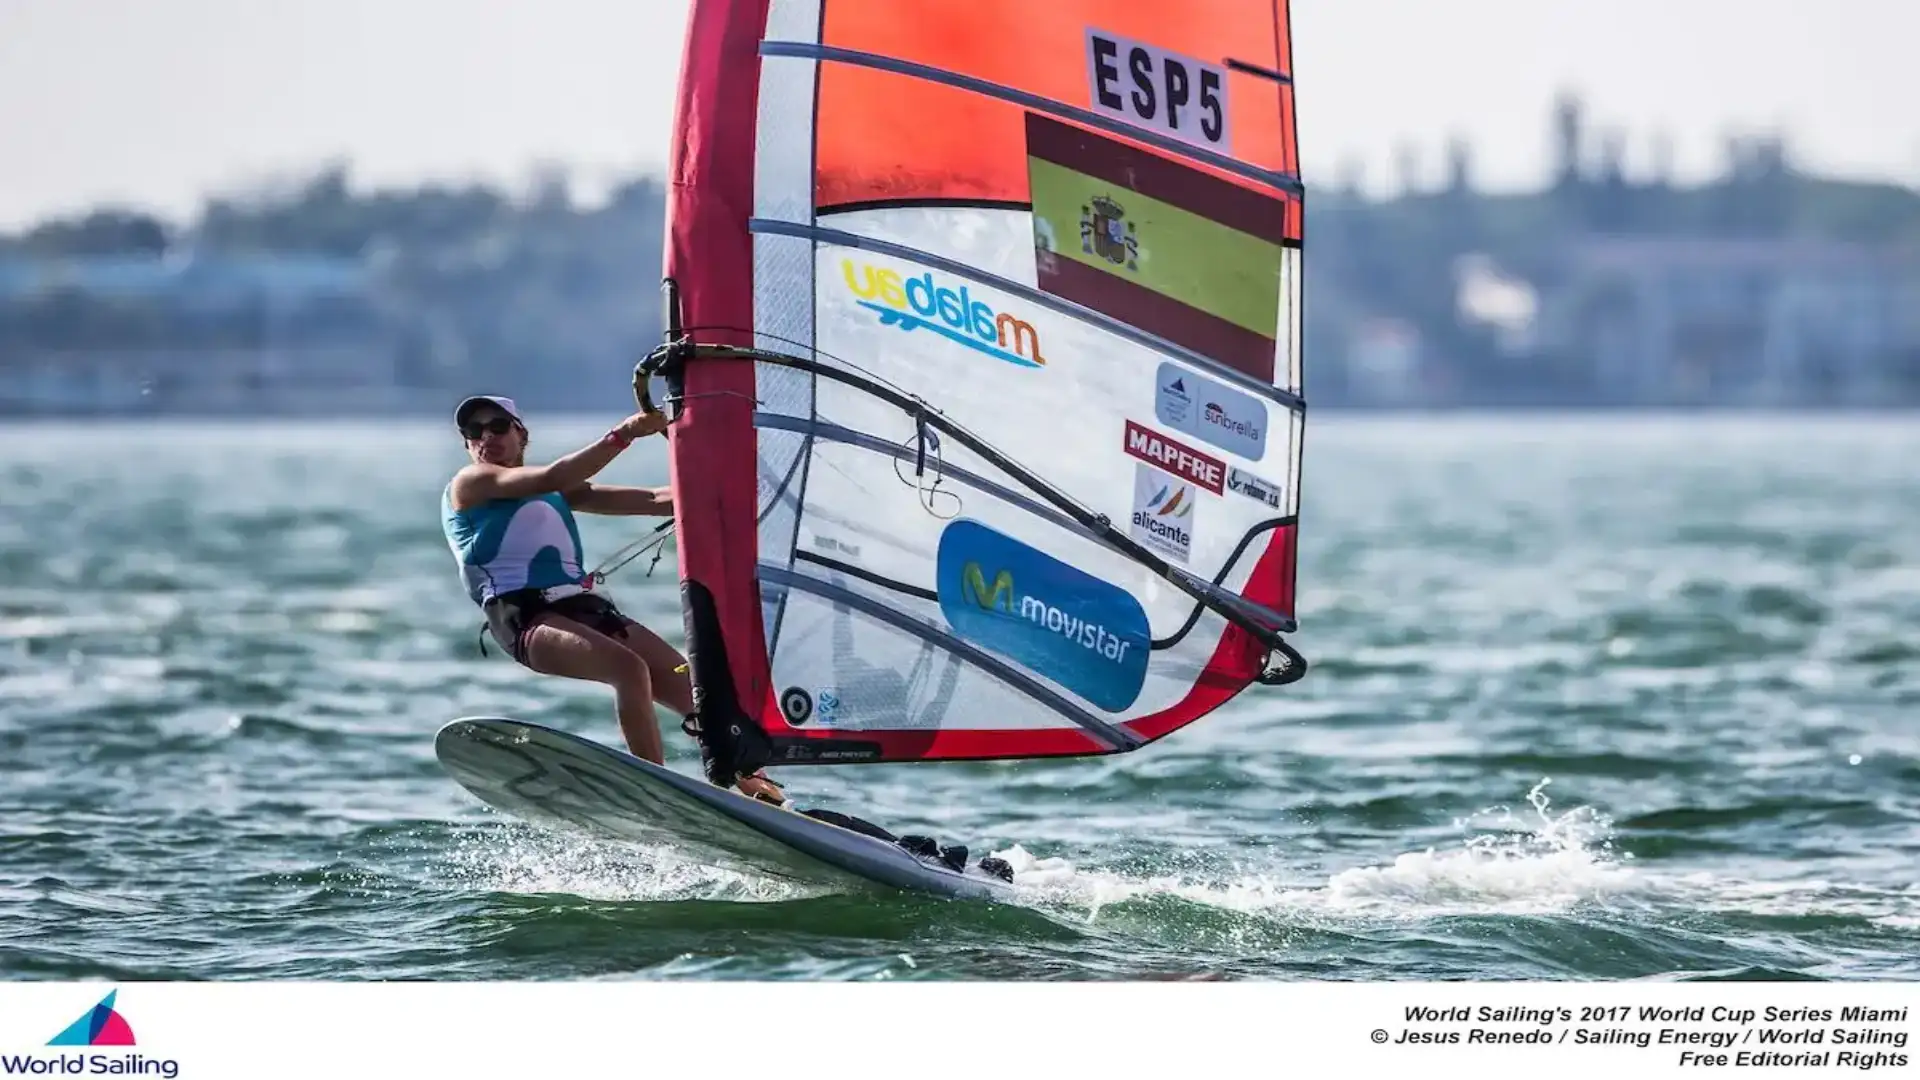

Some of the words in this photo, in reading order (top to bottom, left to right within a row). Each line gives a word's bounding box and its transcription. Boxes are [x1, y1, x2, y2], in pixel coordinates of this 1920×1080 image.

[1128, 429, 1221, 487] MAPFRE
[1132, 510, 1191, 546] alicante
[1020, 595, 1131, 663] movistar
